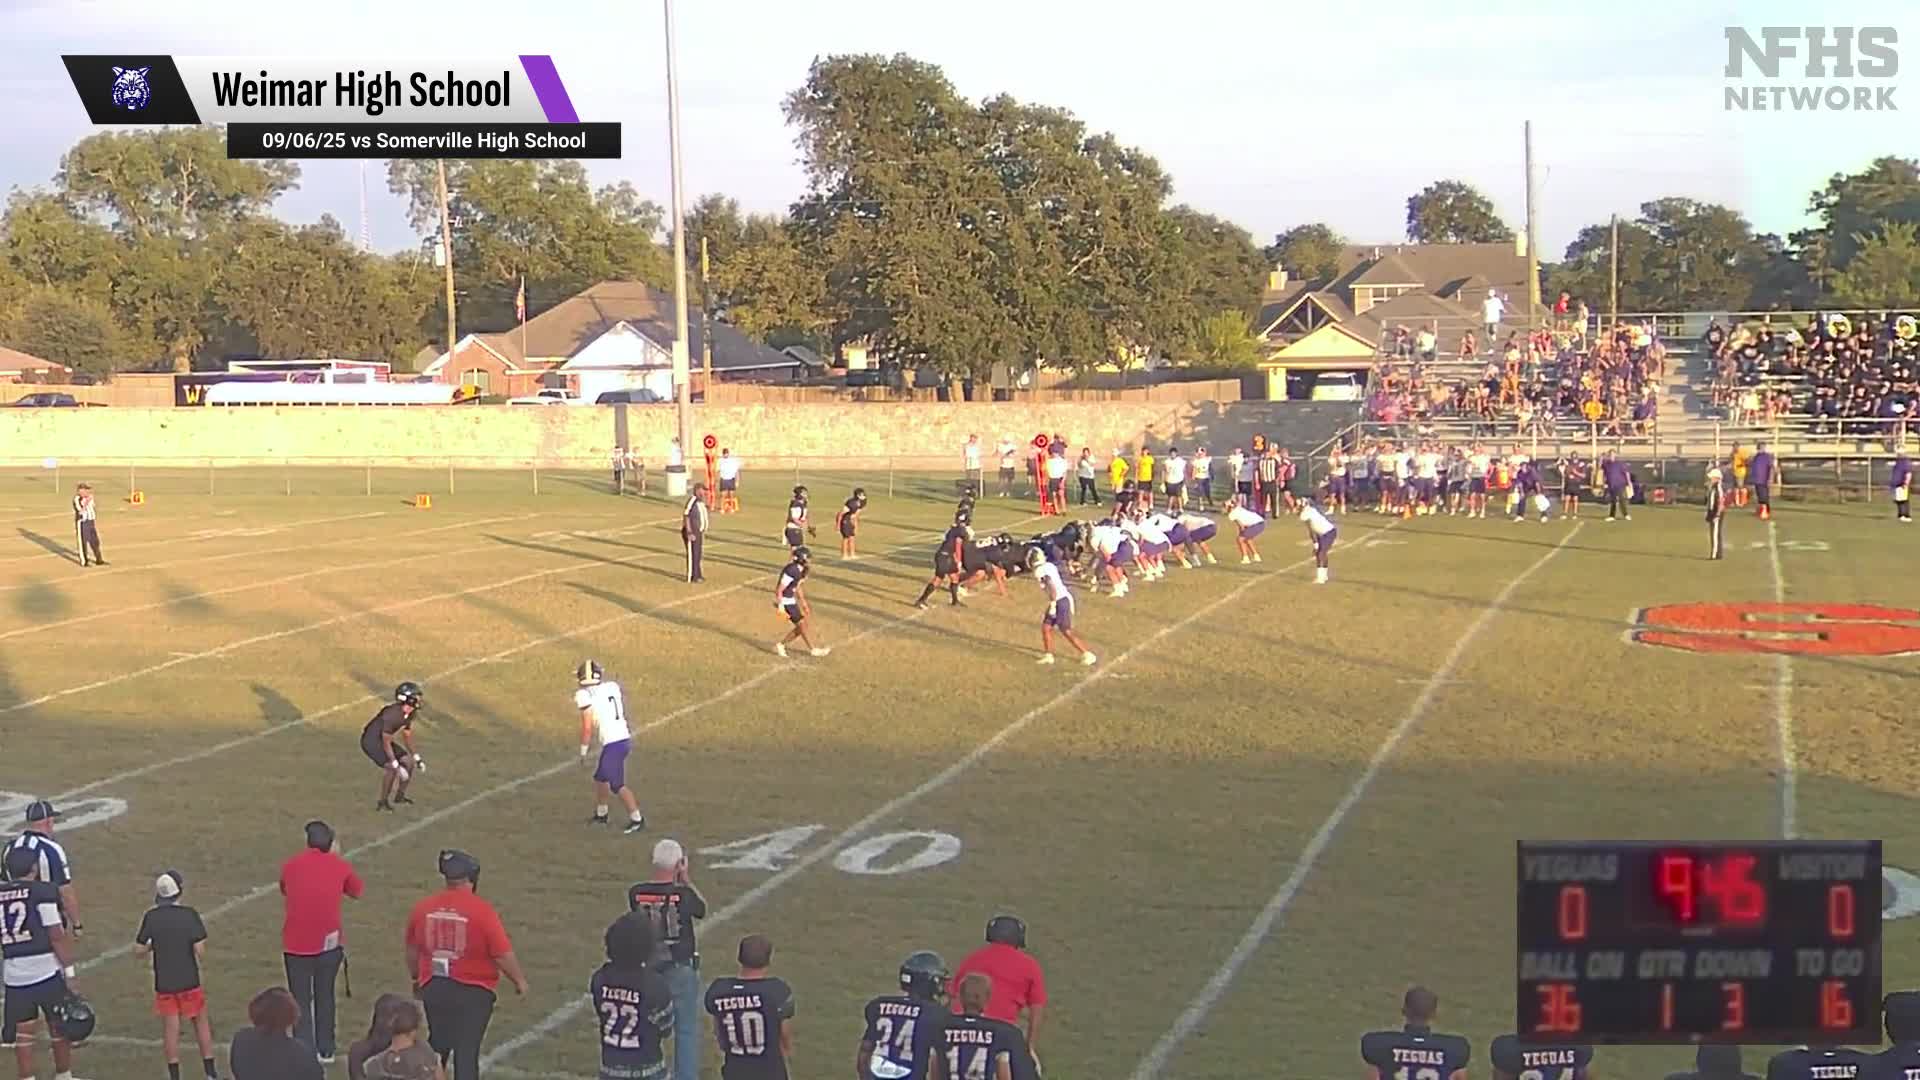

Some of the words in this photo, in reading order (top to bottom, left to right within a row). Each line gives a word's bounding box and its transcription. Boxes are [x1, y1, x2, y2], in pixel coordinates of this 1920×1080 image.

[608, 695, 619, 720] 7
[697, 824, 962, 875] 40
[1779, 855, 1866, 880] VISITOR
[1559, 886, 1588, 939] 0
[1828, 885, 1856, 937] 0
[1520, 952, 1578, 978] BALL
[1585, 952, 1624, 977] ON
[1695, 951, 1772, 977] DOWN
[1795, 951, 1825, 975] TO
[1832, 951, 1864, 975] GO
[715, 996, 762, 1011] YEGUAS
[880, 1003, 920, 1017] YEGUAS
[1536, 983, 1582, 1032] 36
[1661, 983, 1674, 1030] 1
[1722, 982, 1744, 1029] 3
[601, 1001, 640, 1048] 22
[722, 1011, 766, 1055] 10
[945, 1029, 993, 1044] YEGUAS
[872, 1017, 915, 1061] 24
[1393, 1048, 1444, 1064] YEGUAS
[1523, 1050, 1575, 1066] YEGUAS
